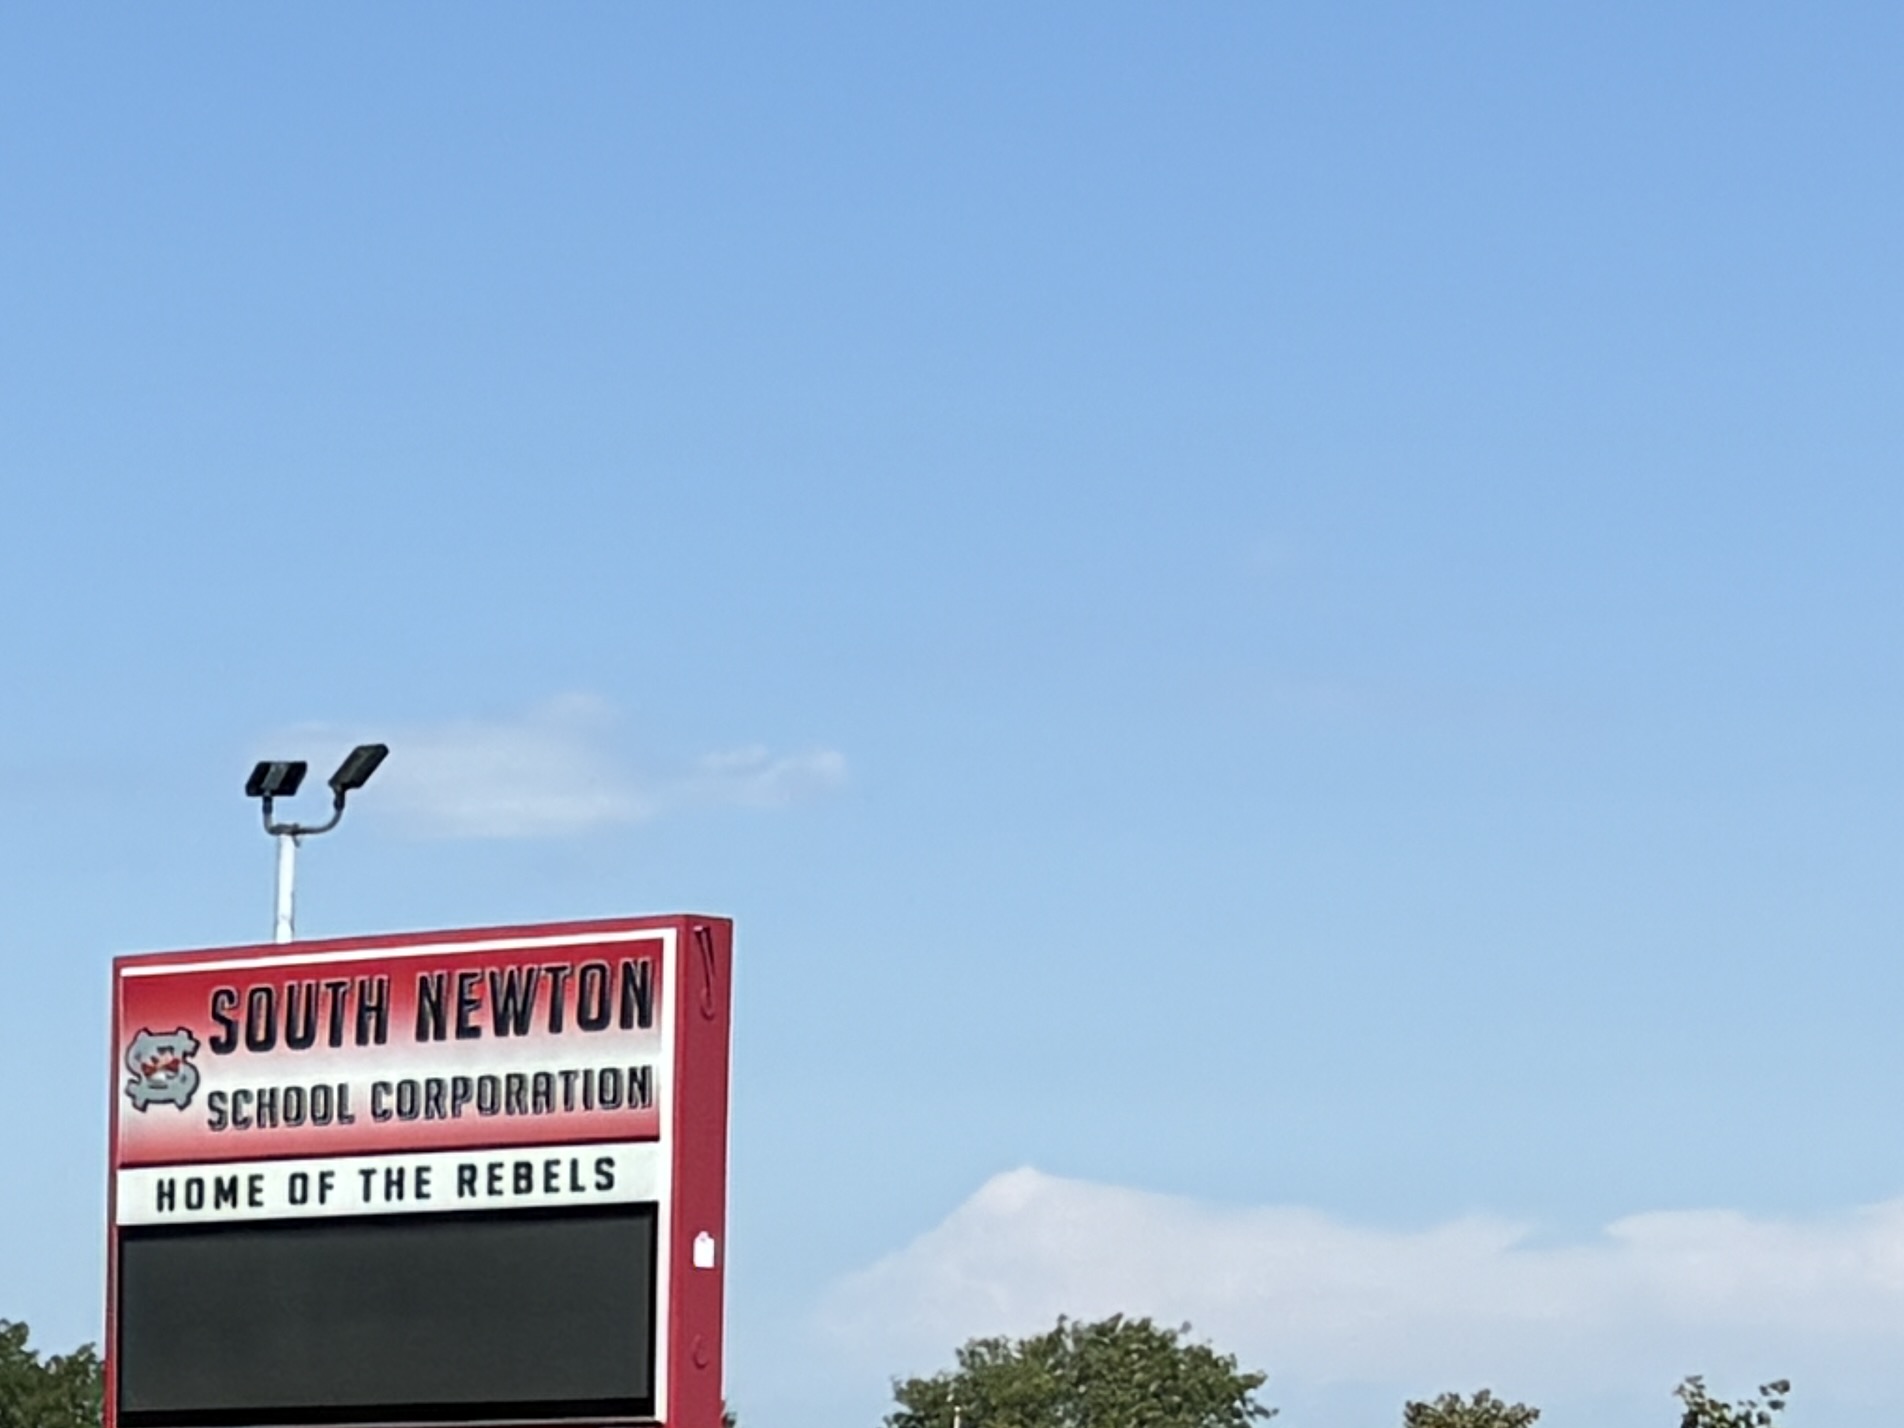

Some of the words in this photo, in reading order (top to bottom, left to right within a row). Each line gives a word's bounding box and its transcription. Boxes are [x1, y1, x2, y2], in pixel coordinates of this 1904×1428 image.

[207, 973, 389, 1056] SOUTH
[414, 959, 654, 1043] NEWTON
[206, 1082, 355, 1133] SCHOOL
[370, 1064, 653, 1123] CORPORATION
[155, 1173, 265, 1213] HOME
[288, 1170, 336, 1206] OF
[359, 1165, 432, 1203] THE
[456, 1156, 616, 1198] REBELS
